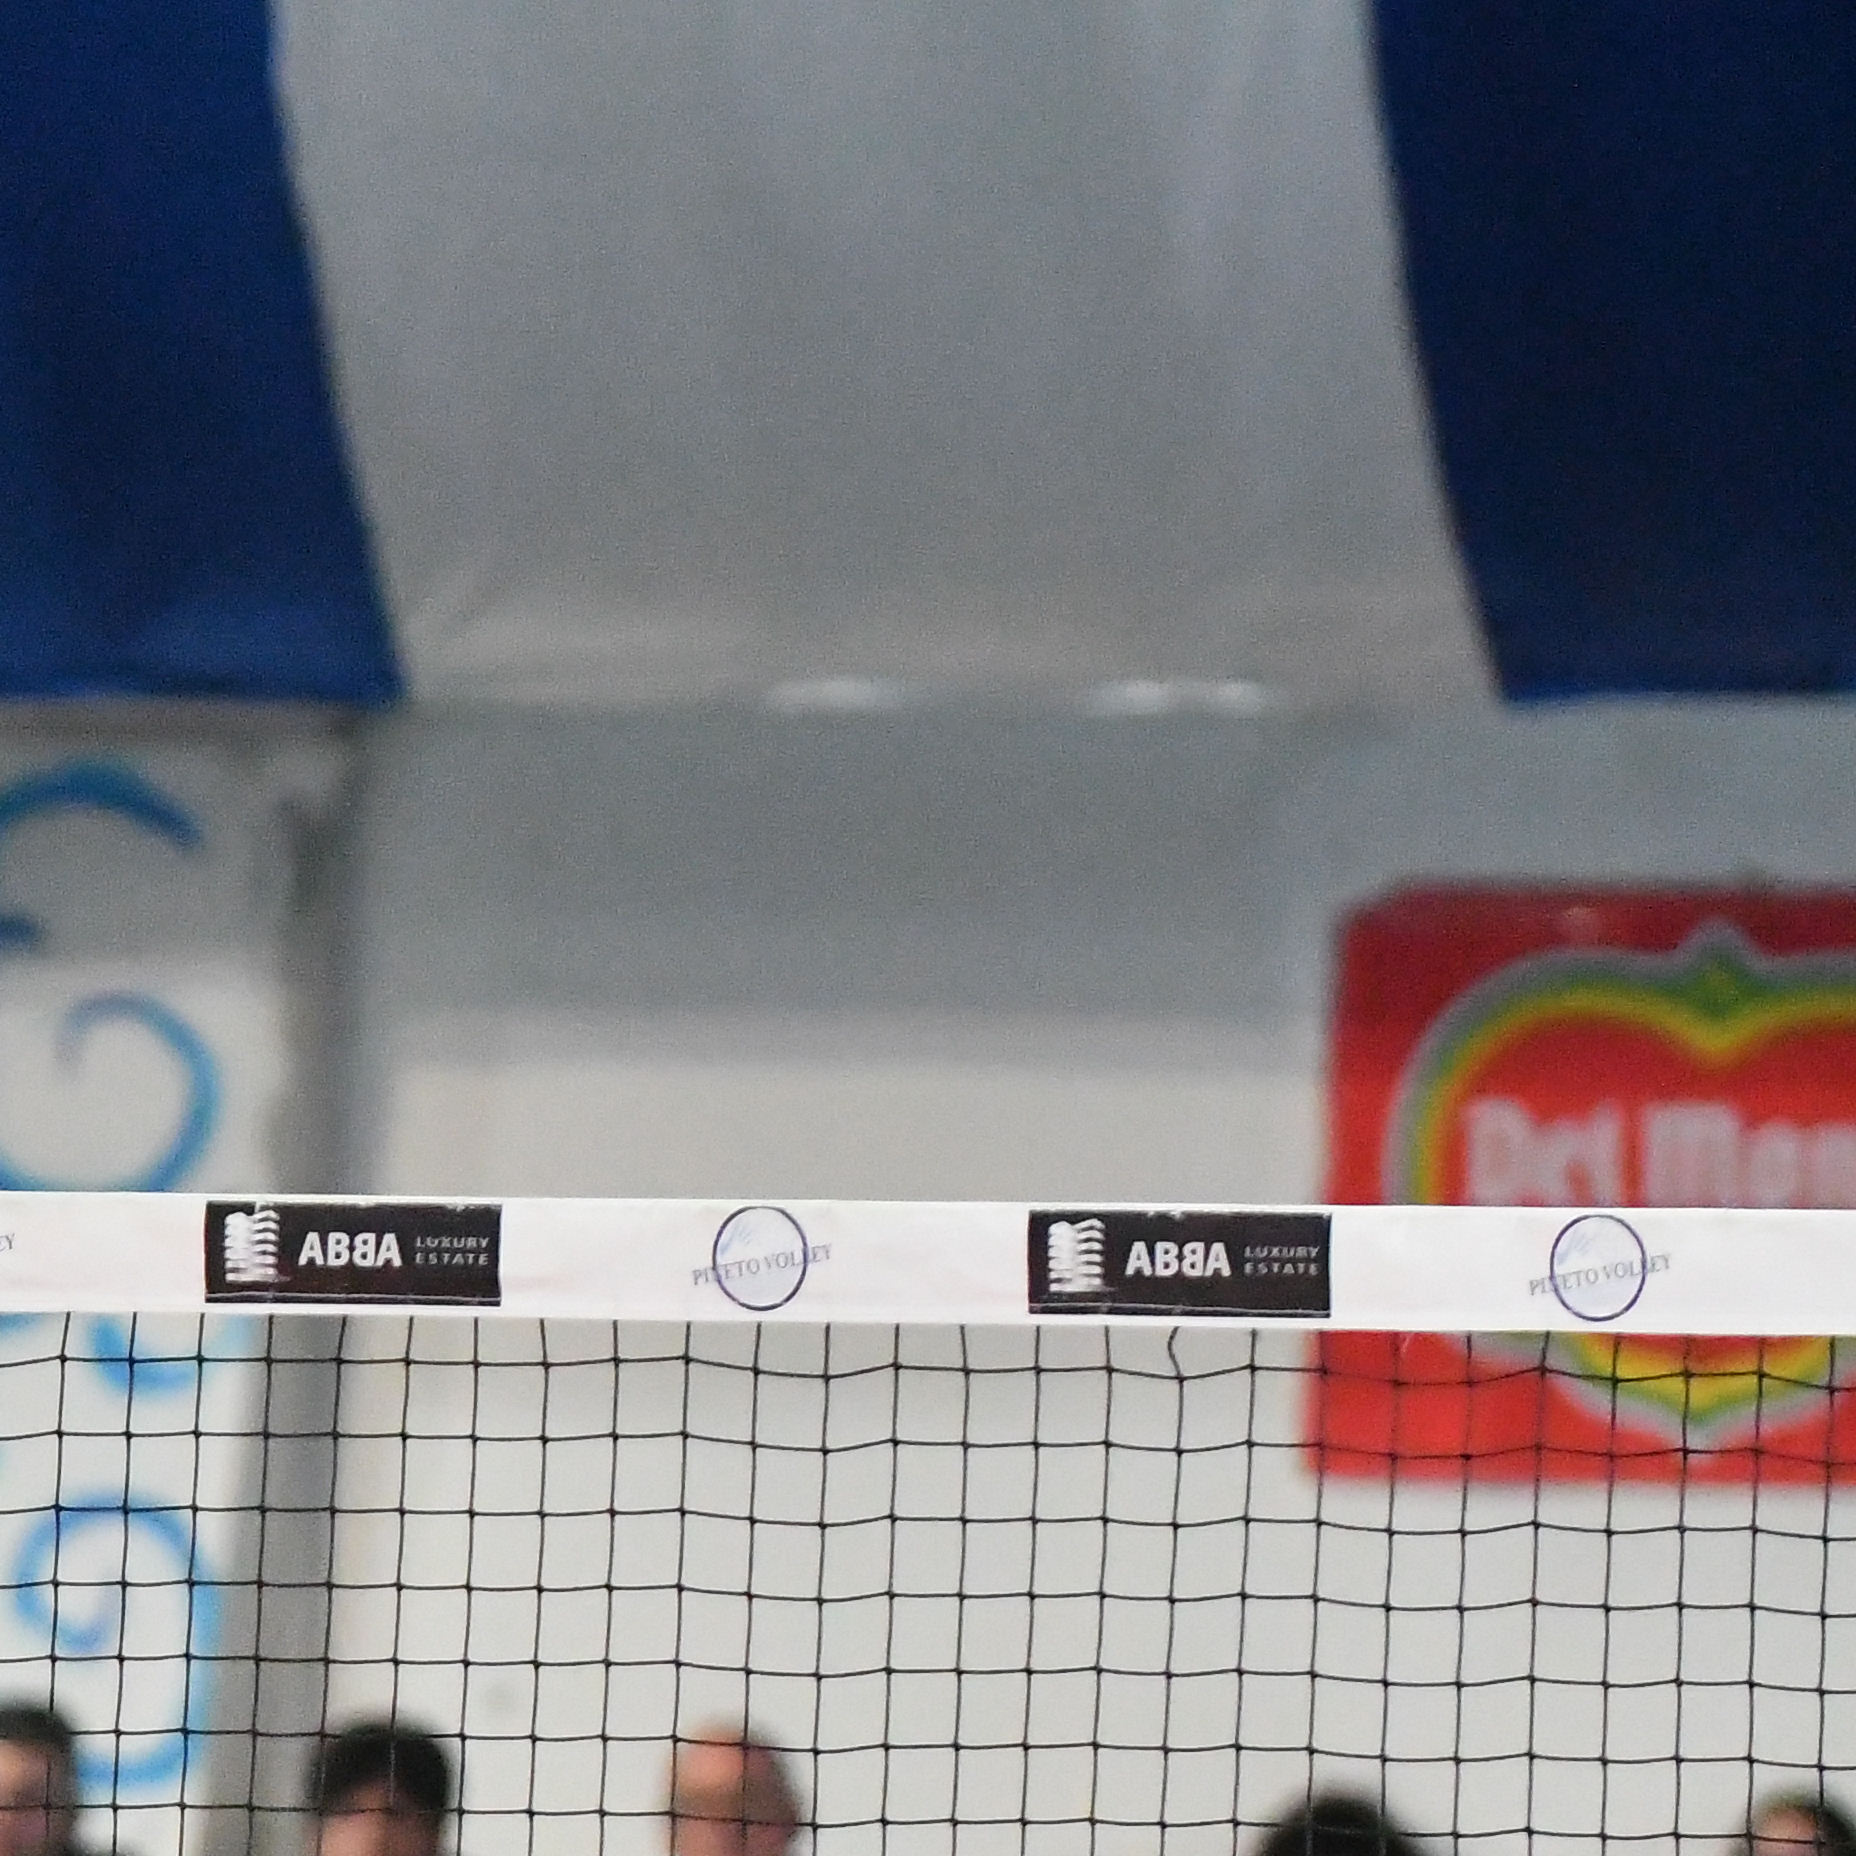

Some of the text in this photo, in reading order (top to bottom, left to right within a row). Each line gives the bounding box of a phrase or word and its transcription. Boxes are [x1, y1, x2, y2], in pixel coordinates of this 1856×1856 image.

[298, 1231, 403, 1267] ABBA
[415, 1235, 490, 1249] LUXURY
[415, 1252, 490, 1267] ESTATE
[1125, 1240, 1232, 1277] ABBA
[1244, 1261, 1321, 1277] ESTATE
